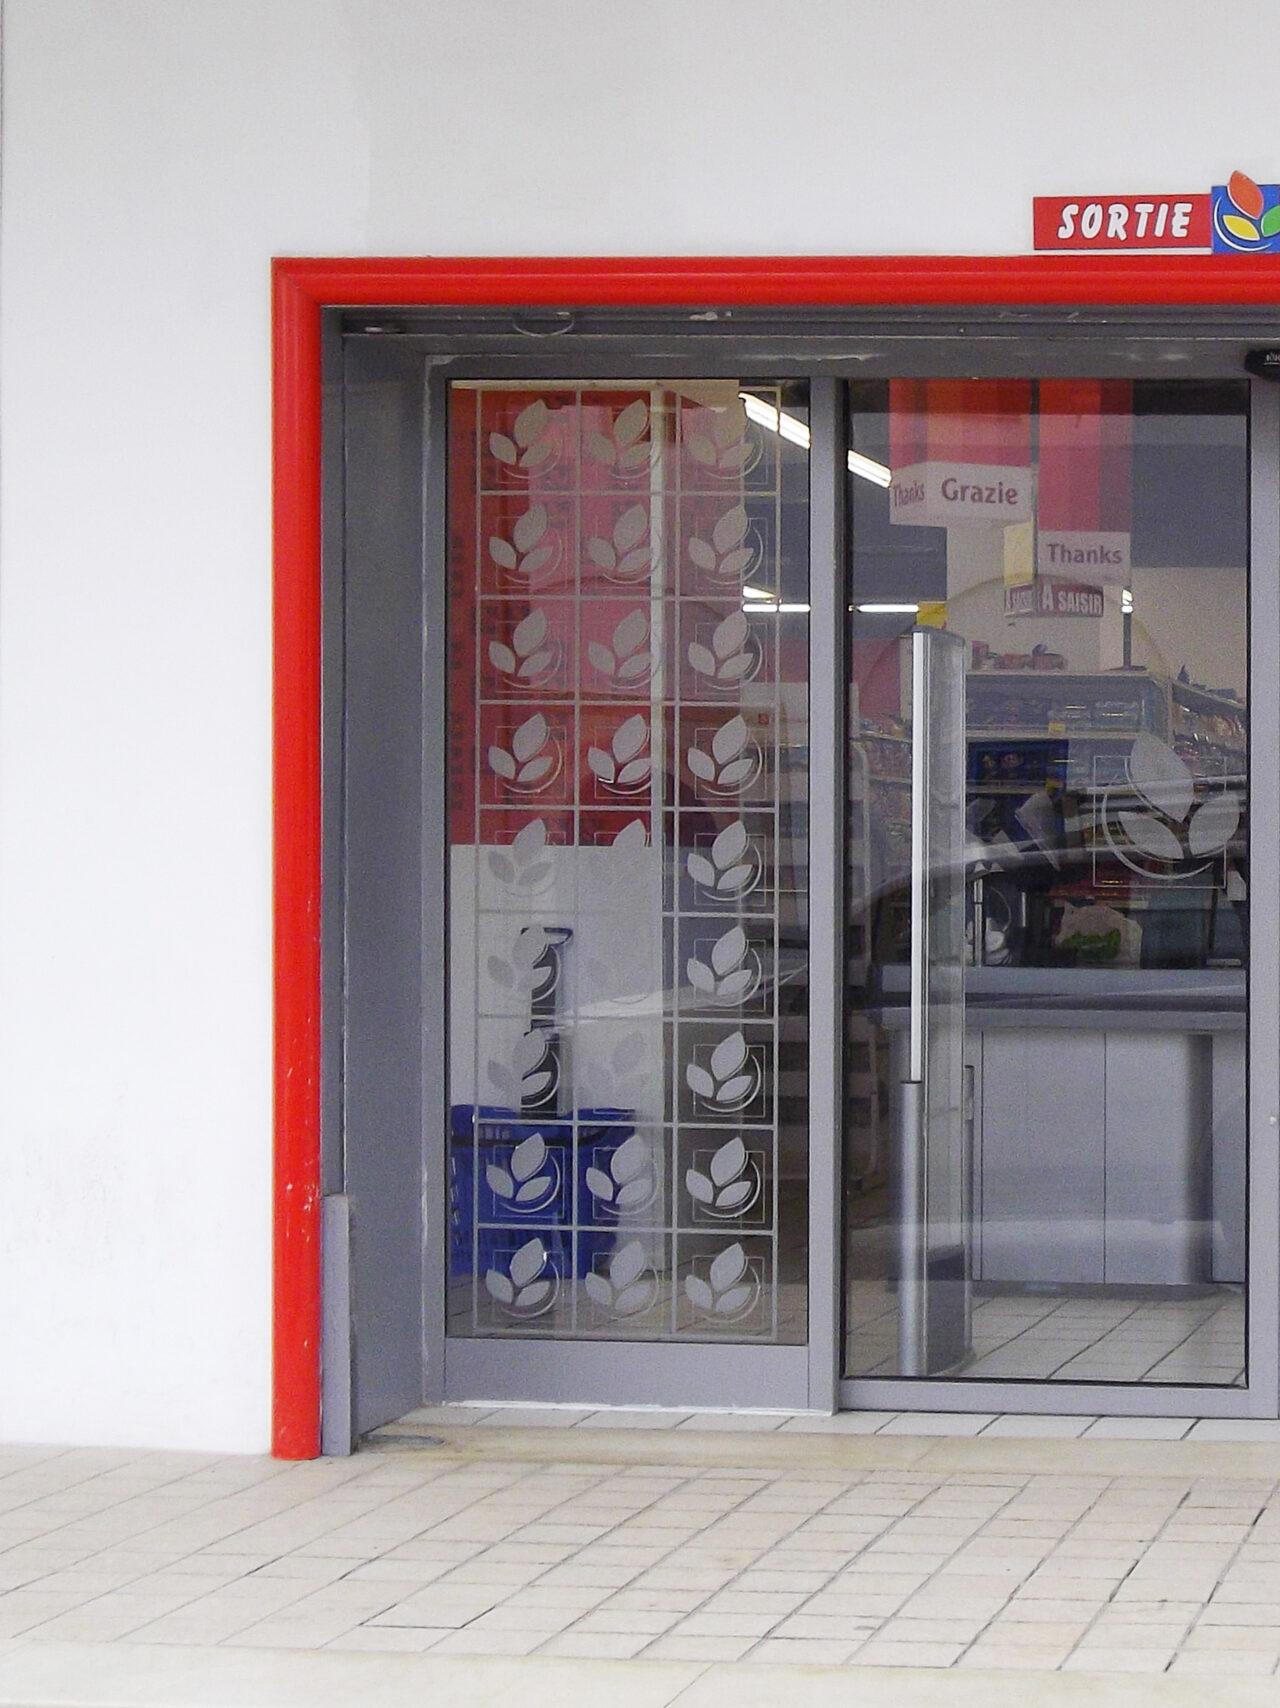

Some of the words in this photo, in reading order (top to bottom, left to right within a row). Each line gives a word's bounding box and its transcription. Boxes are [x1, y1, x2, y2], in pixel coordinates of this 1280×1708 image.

[1057, 203, 1193, 241] SORTIE
[894, 481, 925, 507] Thanks
[941, 478, 1018, 505] Grazie
[1048, 543, 1122, 565] Thanks
[1058, 590, 1102, 614] SAISIR
